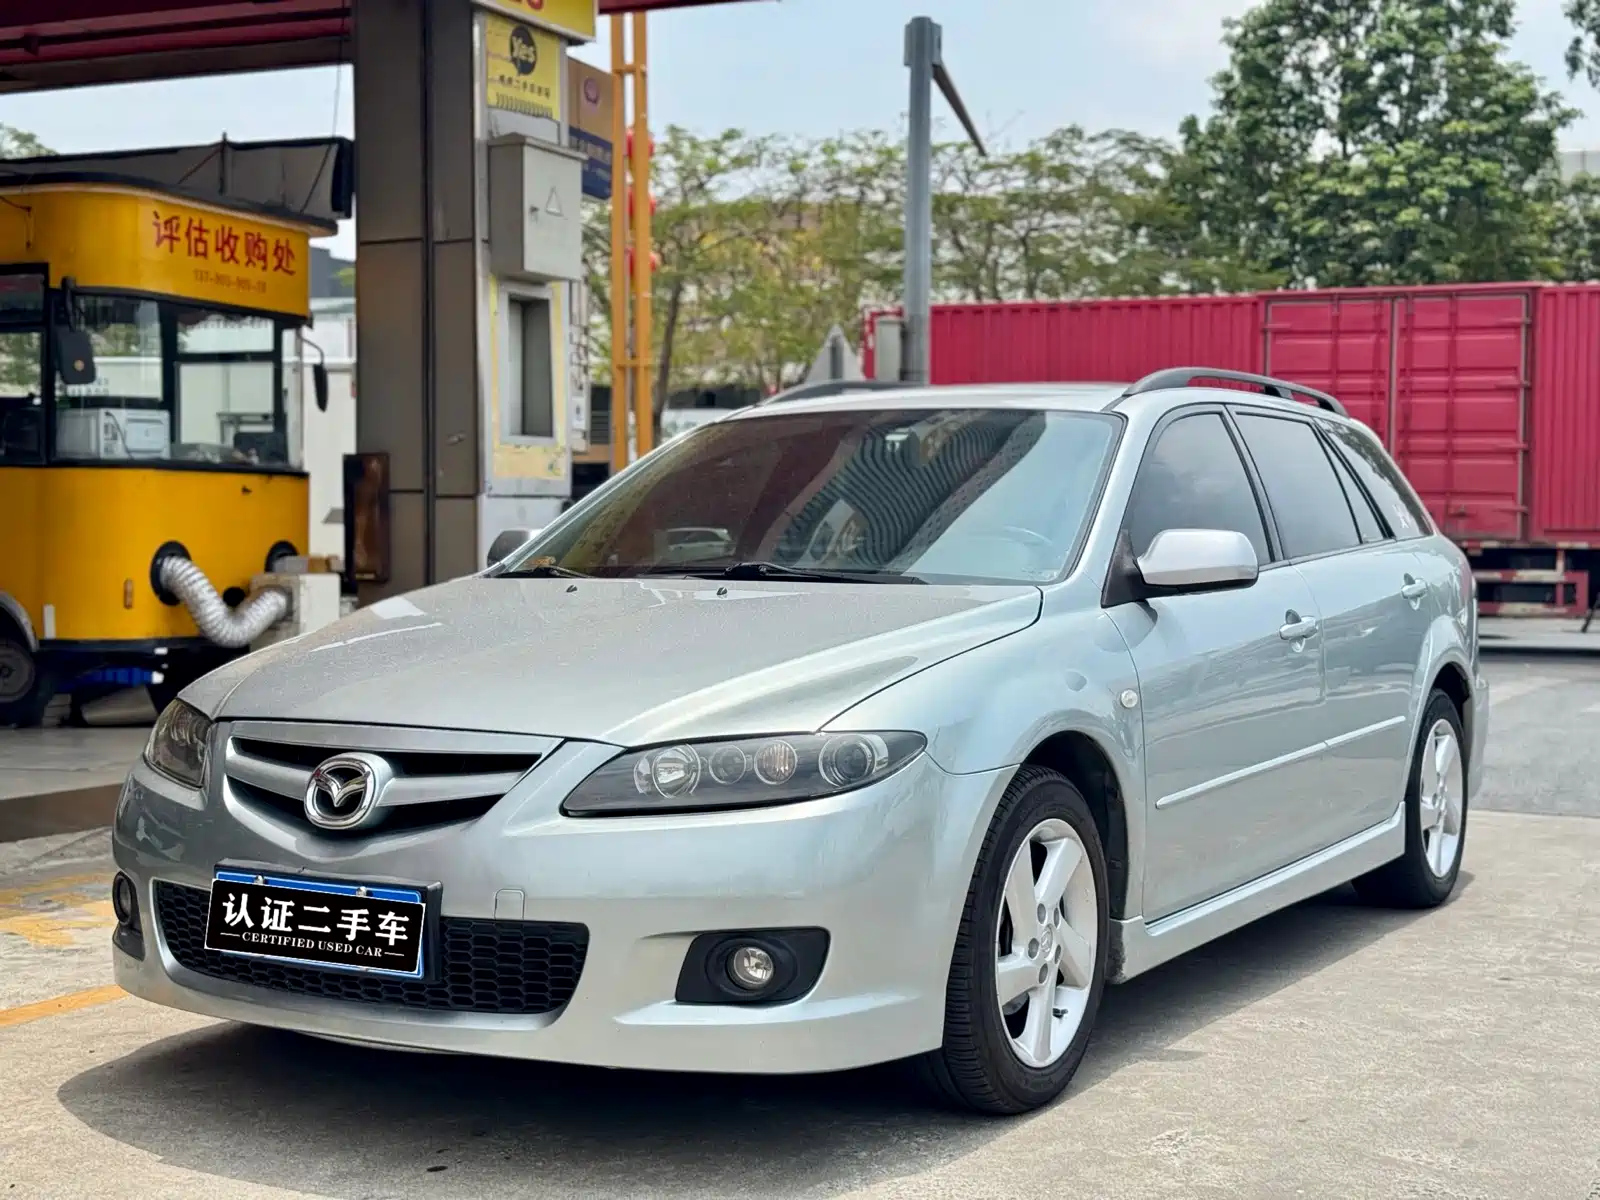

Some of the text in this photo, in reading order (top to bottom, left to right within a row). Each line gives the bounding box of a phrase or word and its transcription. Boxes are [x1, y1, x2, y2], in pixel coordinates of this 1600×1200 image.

[511, 35, 535, 63] Yes
[152, 210, 296, 276] 评估收购处
